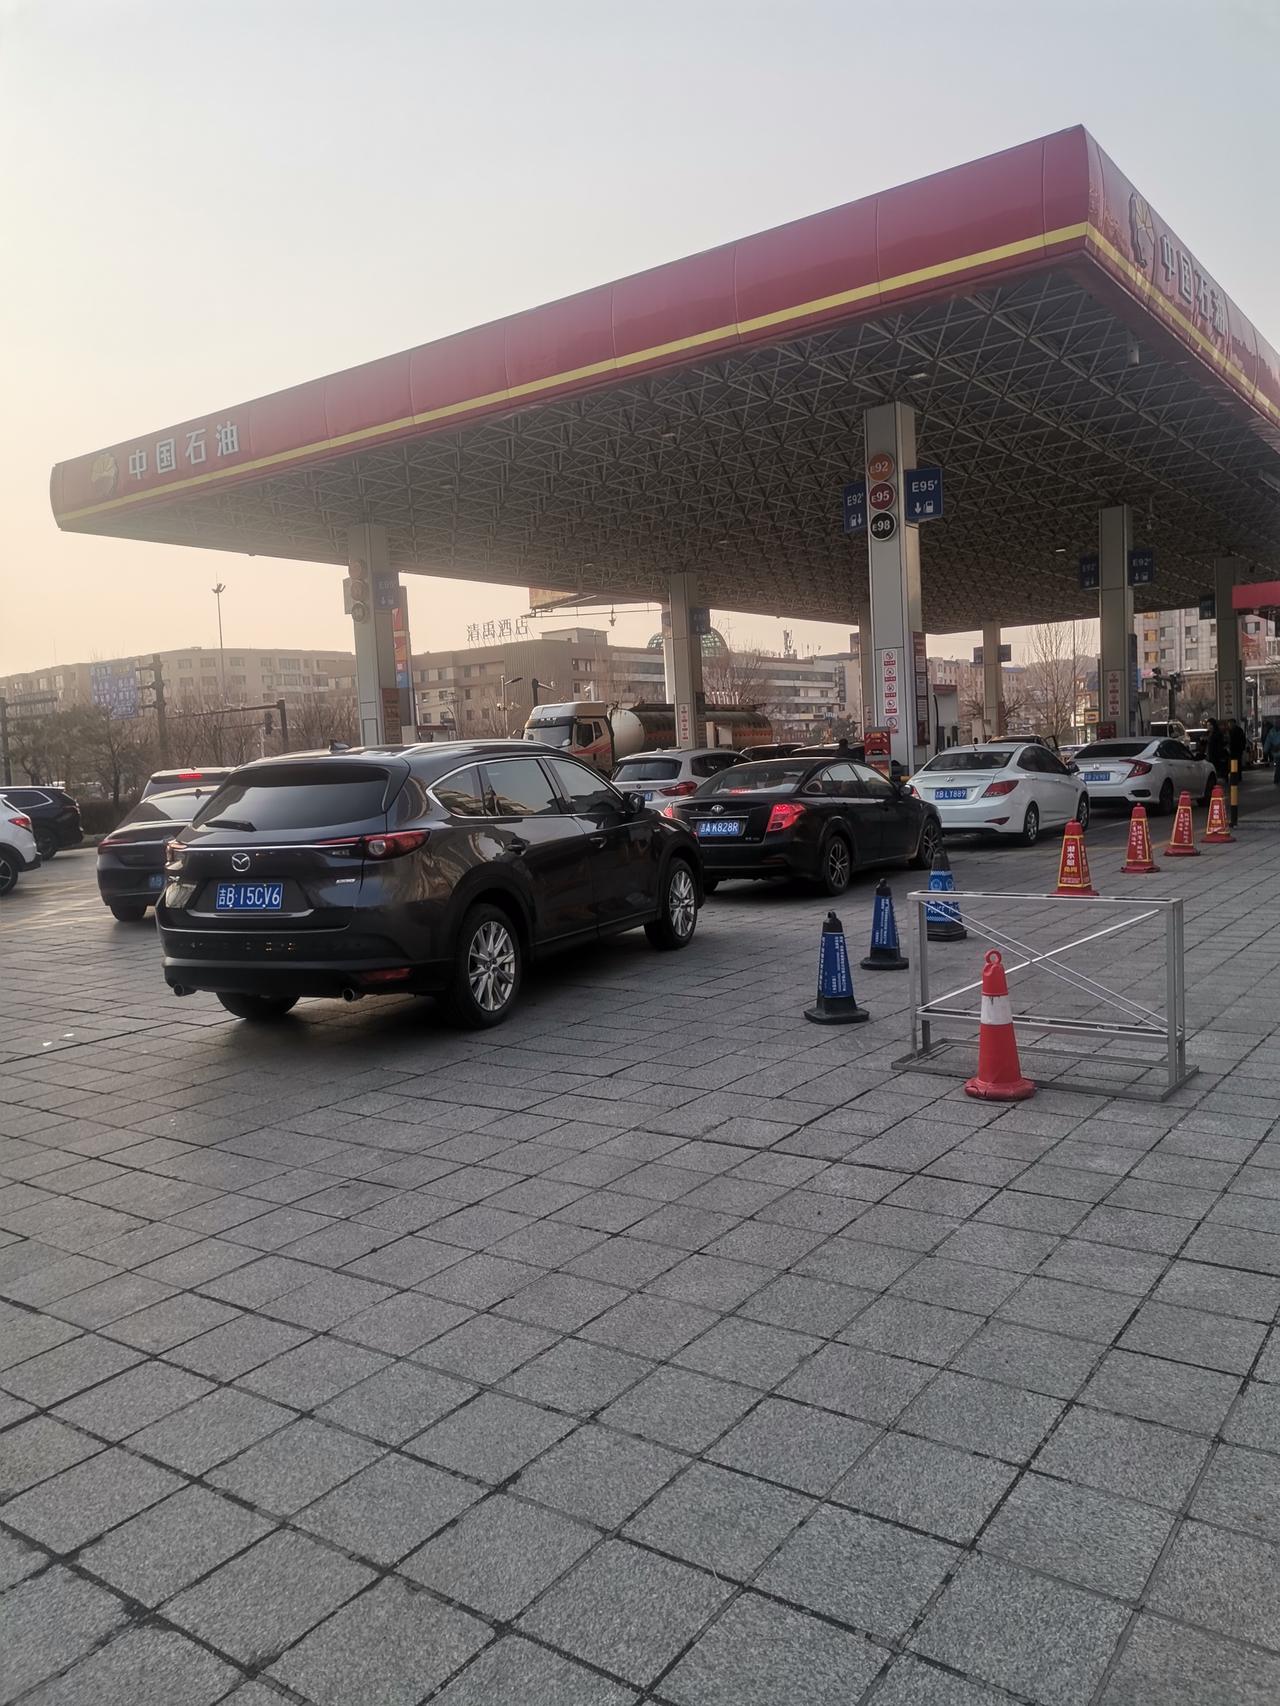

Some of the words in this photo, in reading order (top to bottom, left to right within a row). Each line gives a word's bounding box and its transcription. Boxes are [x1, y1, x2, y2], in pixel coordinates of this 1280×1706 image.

[1160, 234, 1225, 337] 中国石油
[128, 420, 239, 480] 中国石油
[870, 461, 889, 474] E92
[871, 490, 890, 503] E95
[872, 520, 891, 532] E98
